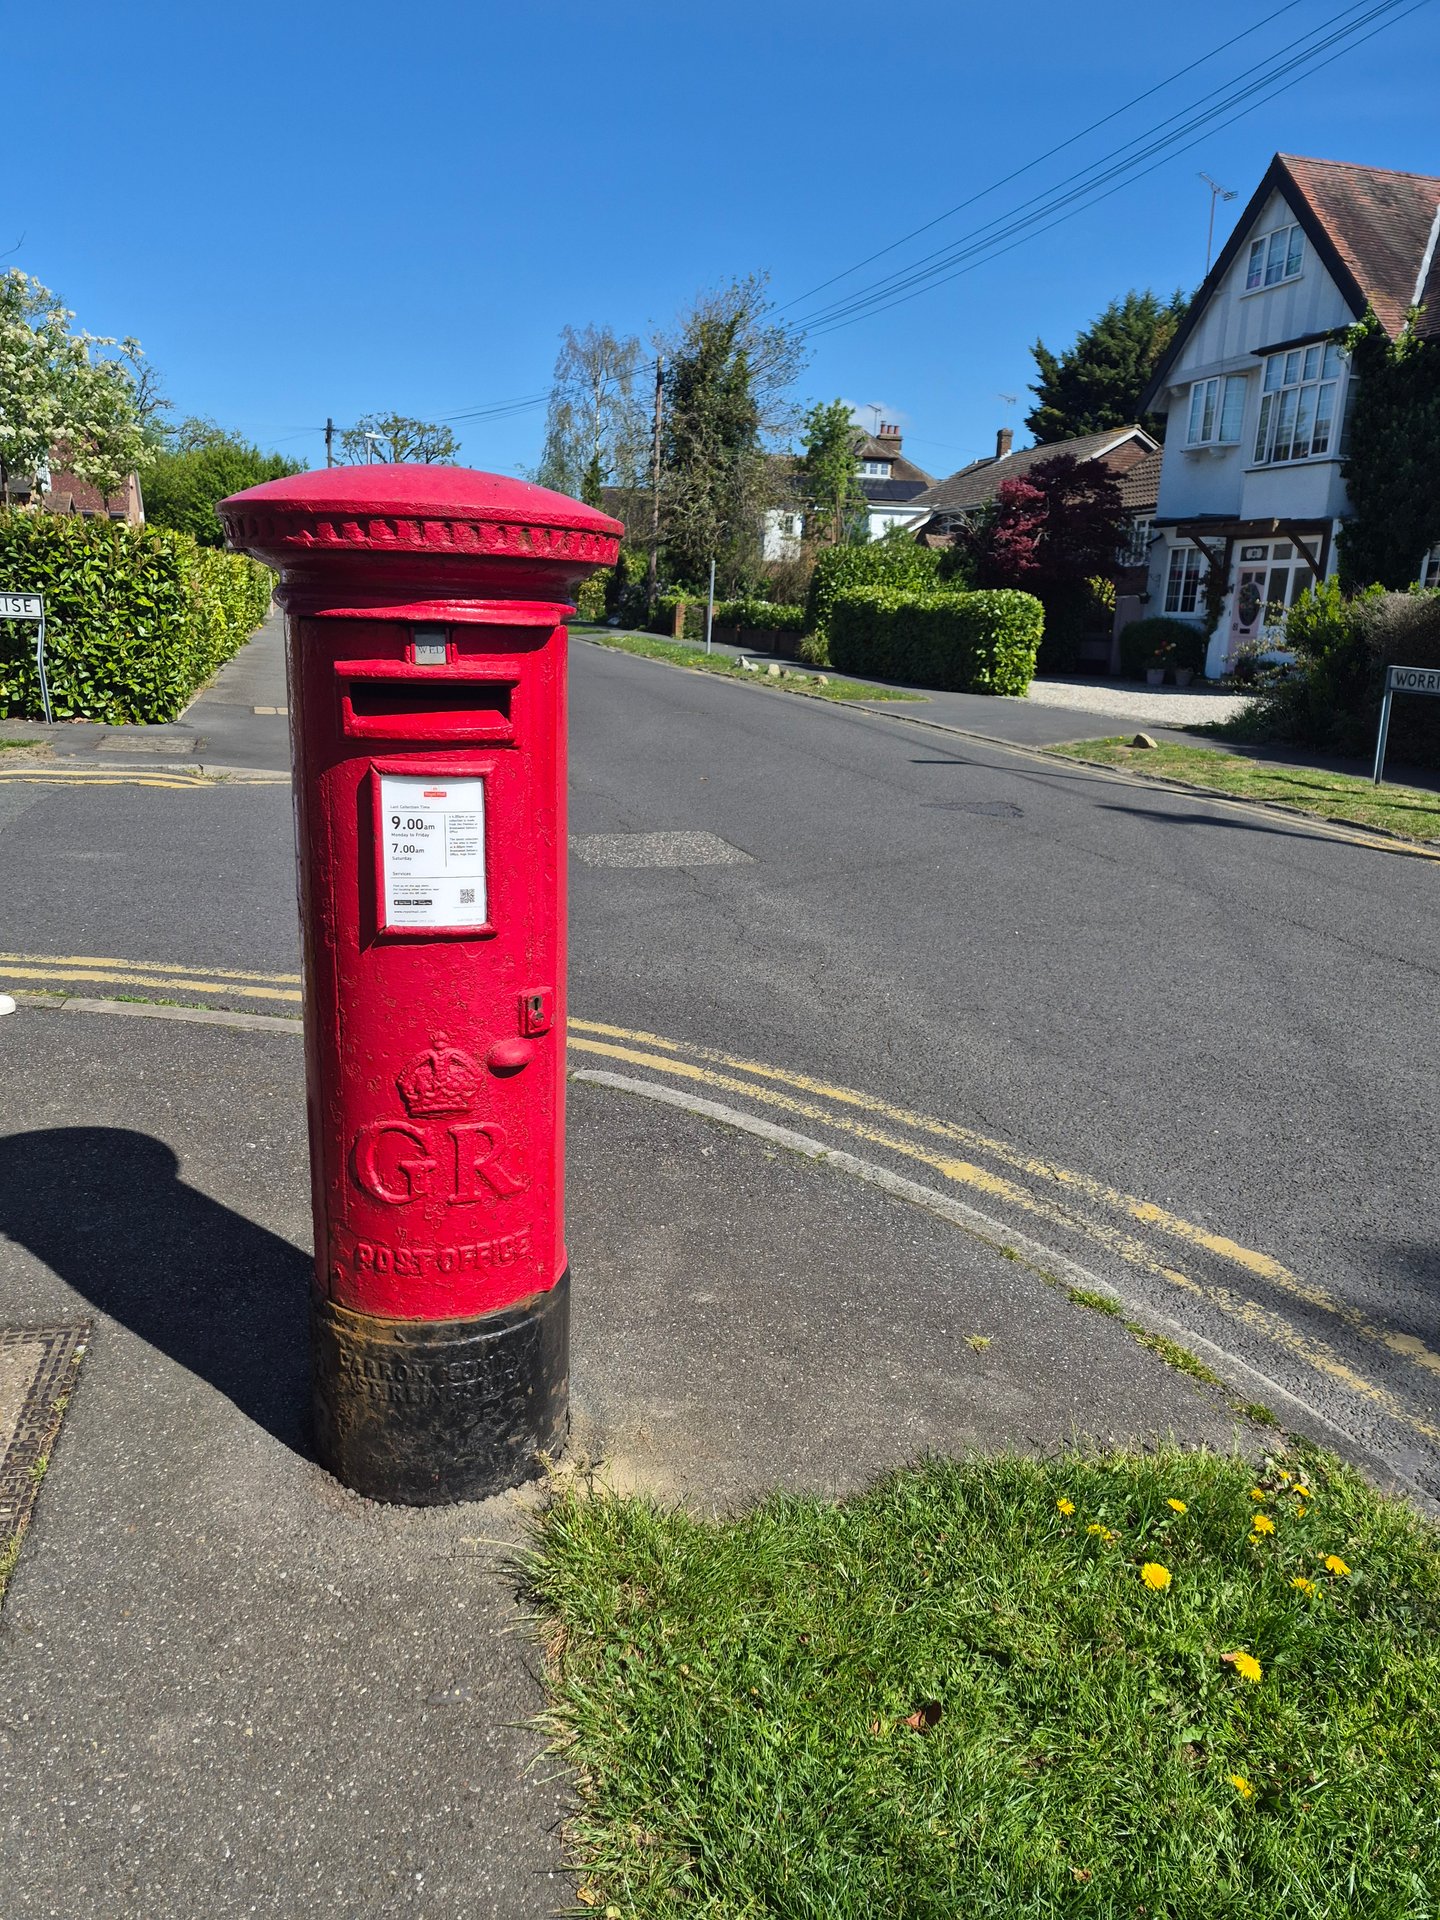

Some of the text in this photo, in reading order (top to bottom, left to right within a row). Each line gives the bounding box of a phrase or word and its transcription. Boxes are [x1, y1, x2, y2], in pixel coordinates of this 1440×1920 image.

[0, 598, 33, 613] ISE
[418, 646, 445, 654] WED
[391, 815, 436, 830] 9.00am
[392, 843, 425, 854] 7.00am
[351, 1119, 530, 1206] GR
[356, 1228, 531, 1276] POST OFFICE
